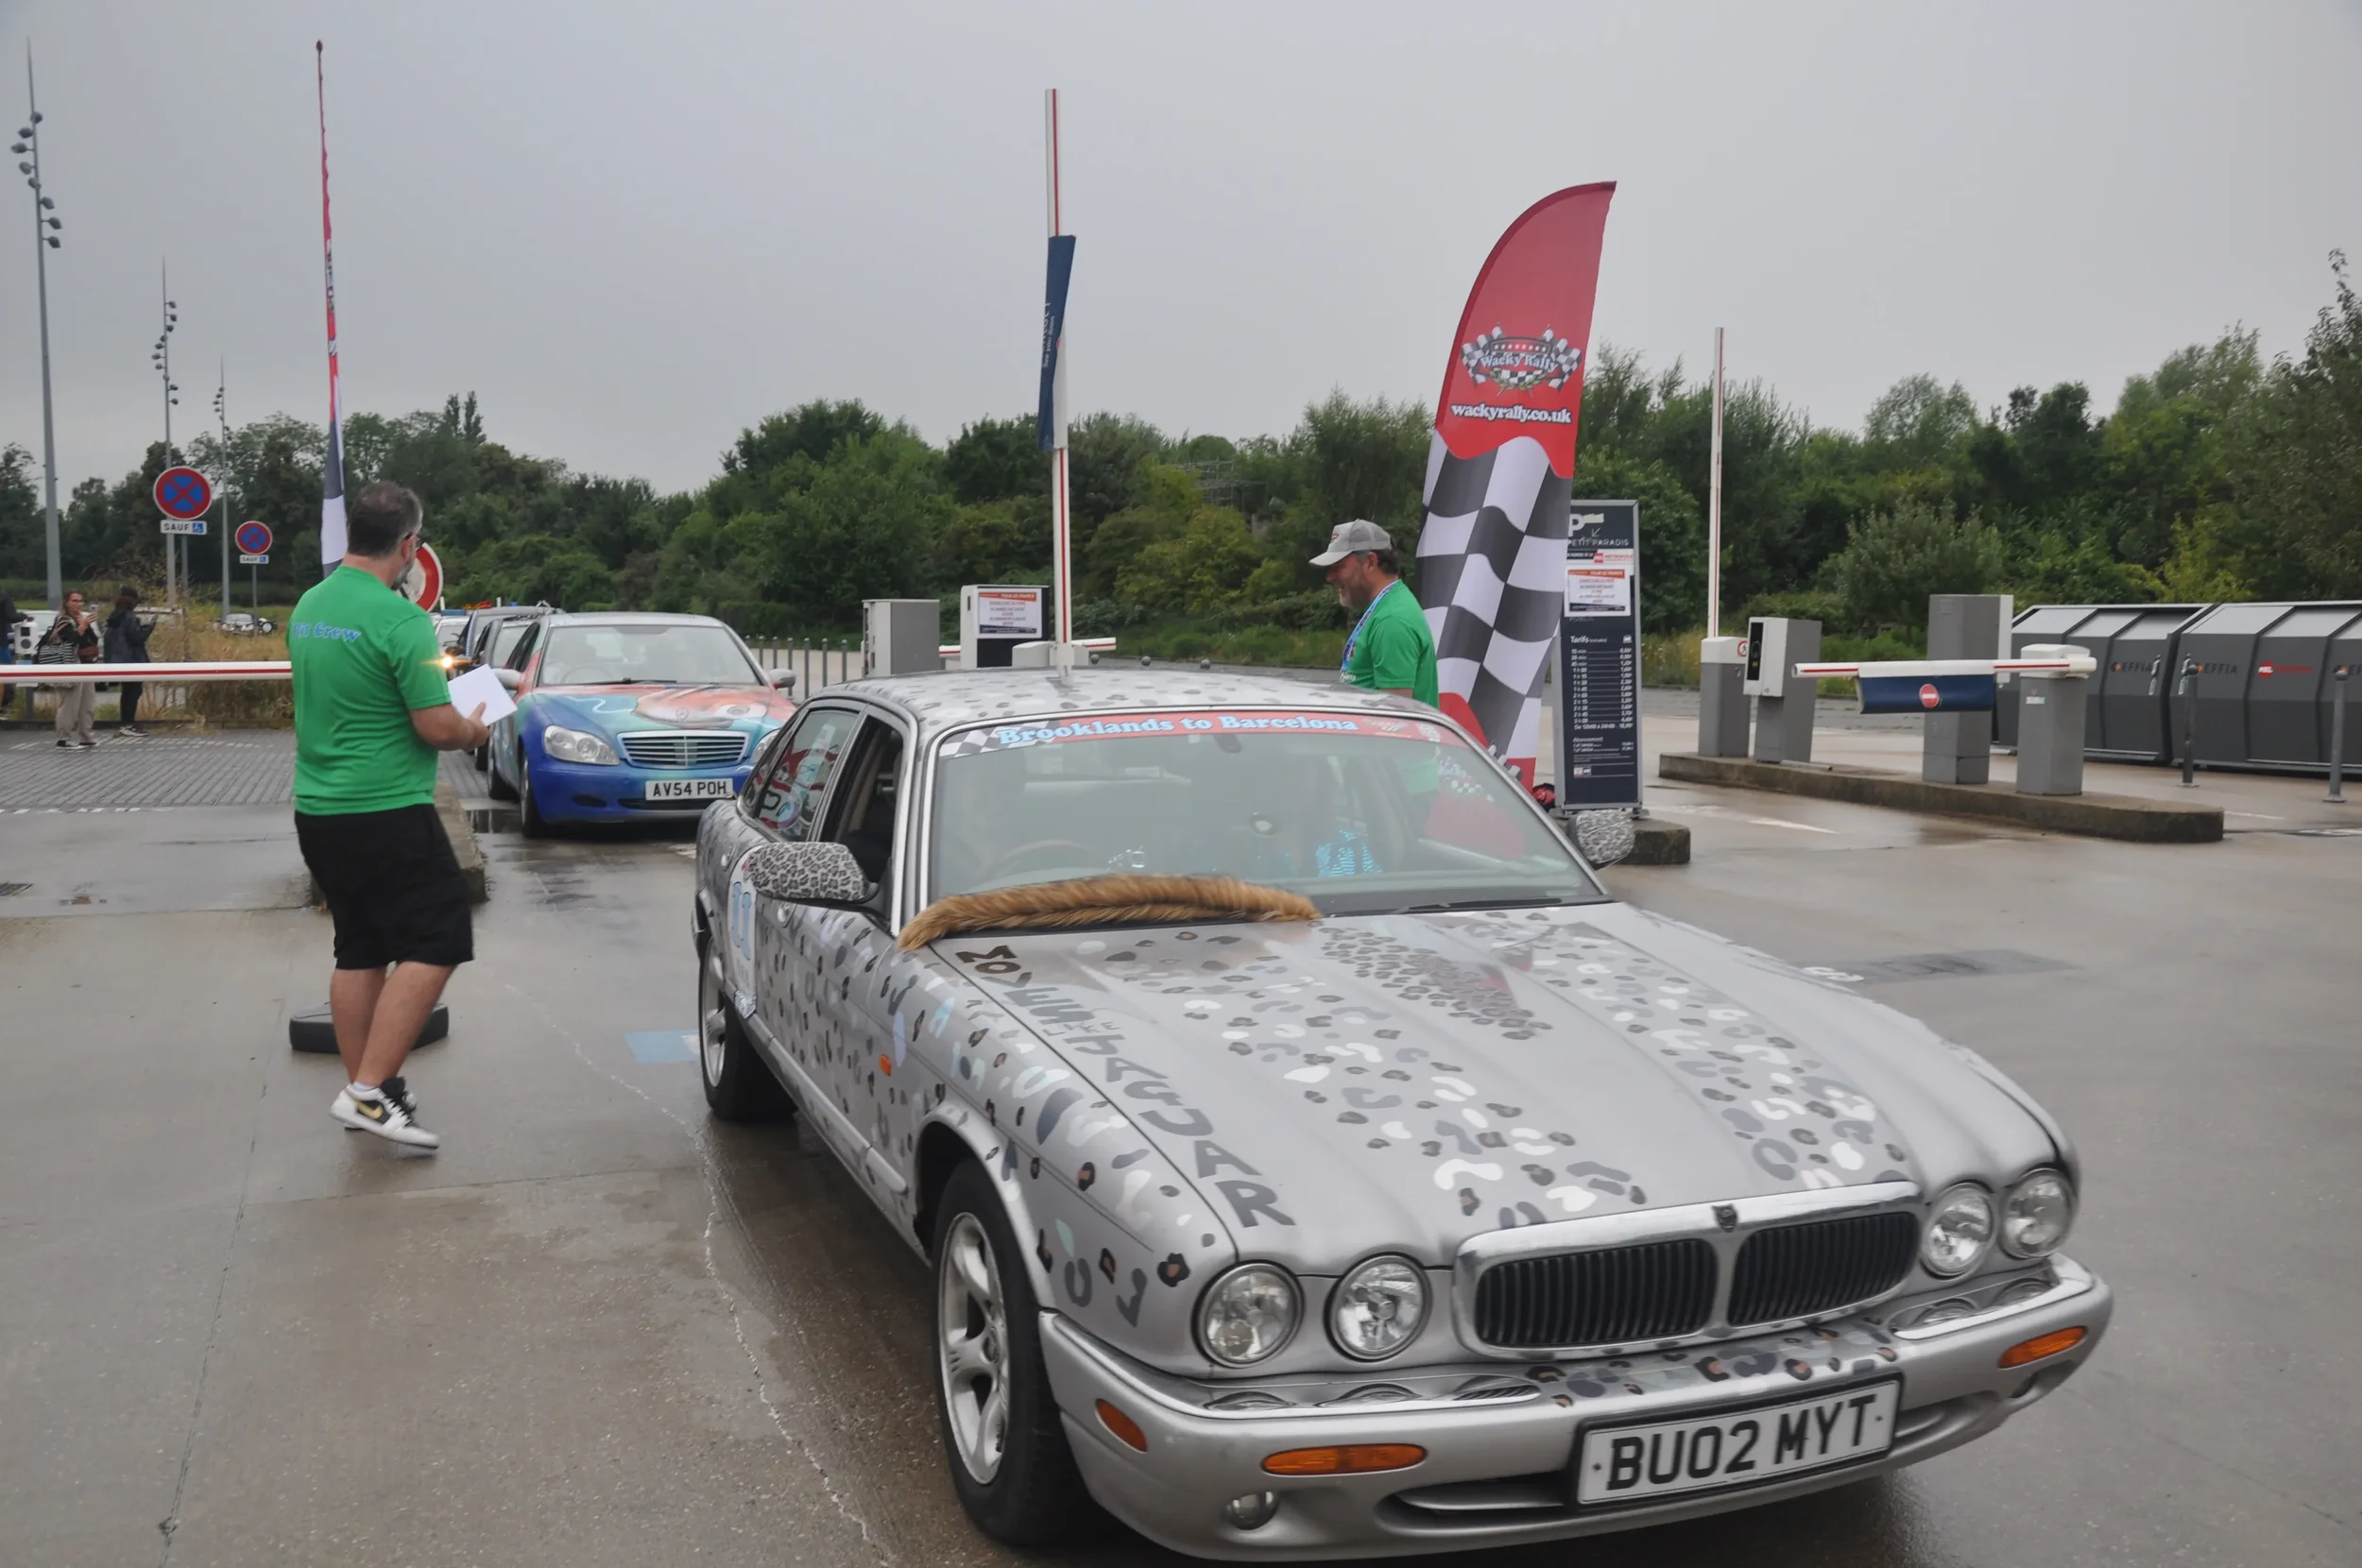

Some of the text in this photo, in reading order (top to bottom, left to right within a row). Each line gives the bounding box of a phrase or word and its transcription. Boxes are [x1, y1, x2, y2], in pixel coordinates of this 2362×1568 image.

[1481, 351, 1558, 373] Wacky Rally
[1451, 403, 1572, 424] wackyrally.co.uk
[163, 522, 190, 532] SAUF
[1592, 538, 1630, 547] PARADIS
[314, 622, 362, 643] Crew
[2203, 663, 2237, 674] EFFIA
[998, 718, 1174, 745] Brooklands
[1179, 717, 1213, 730] to
[1217, 715, 1360, 731] Barcelona
[653, 781, 727, 797] AV54 POH
[955, 945, 1296, 1228] MOVES LIKE JAGUAR
[1605, 1393, 1877, 1491] BU02 MYT
